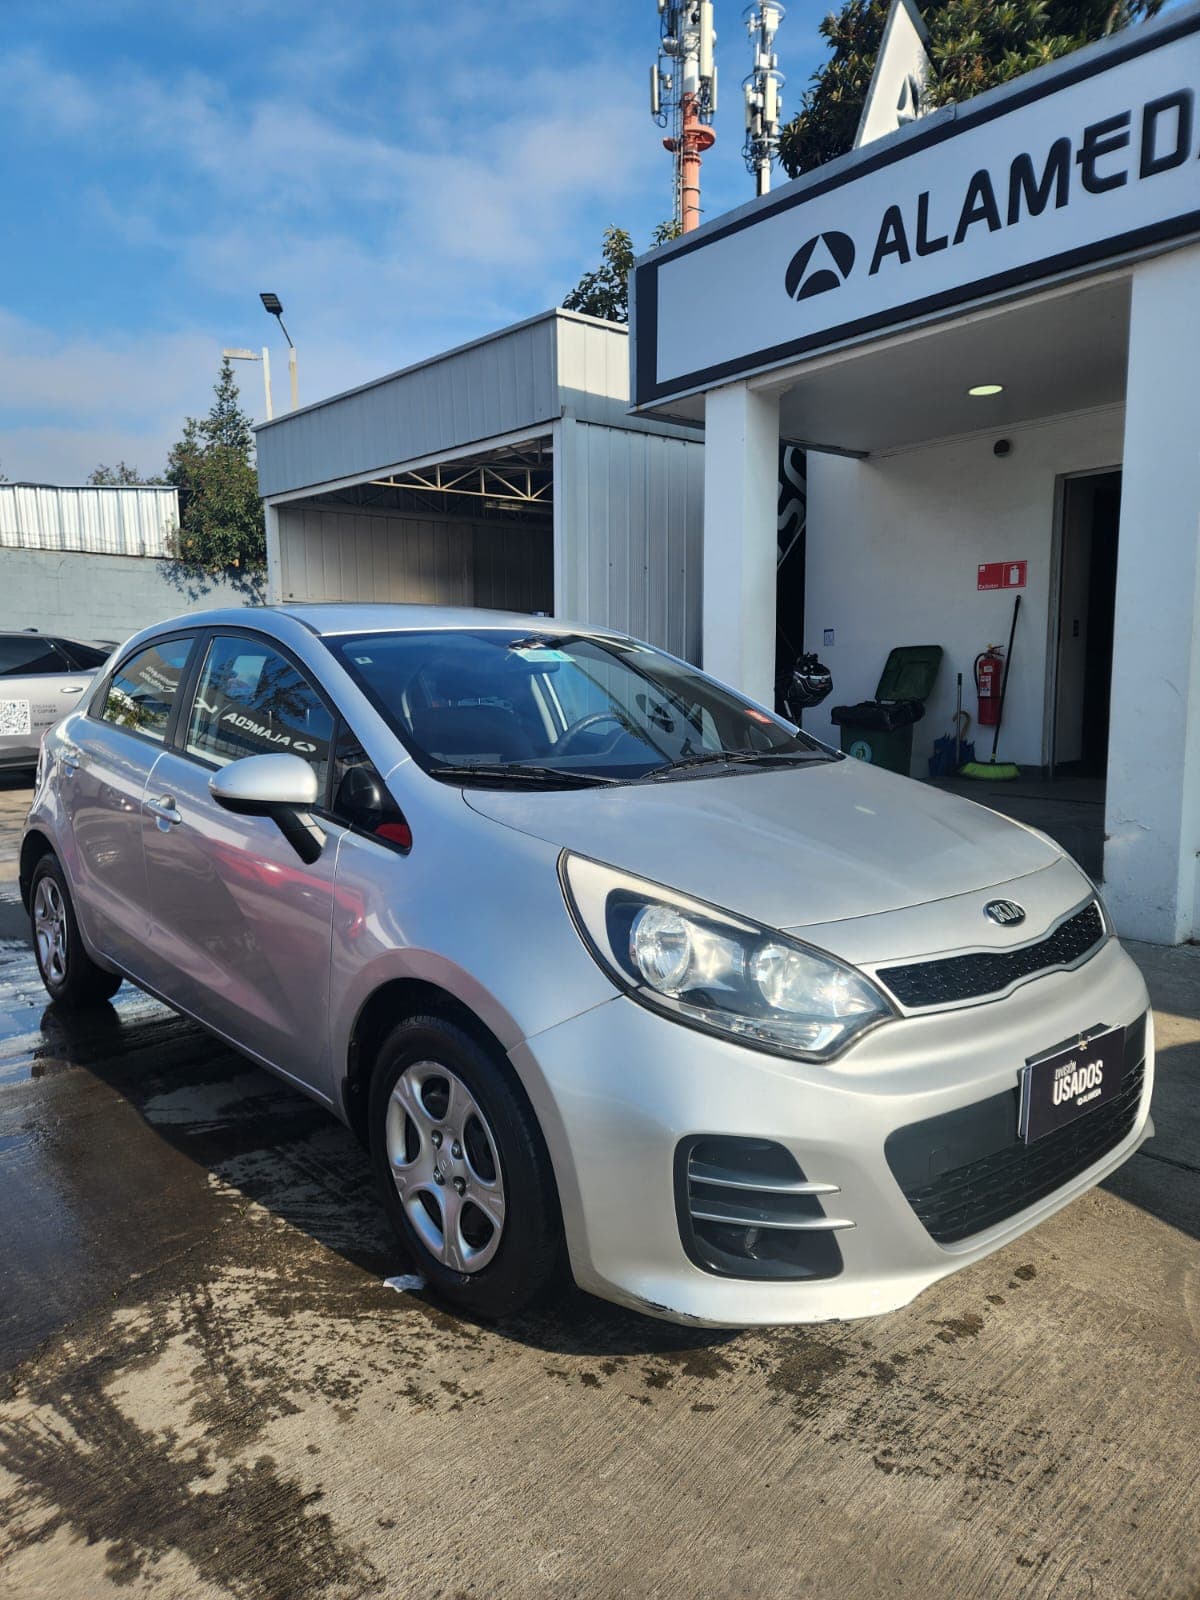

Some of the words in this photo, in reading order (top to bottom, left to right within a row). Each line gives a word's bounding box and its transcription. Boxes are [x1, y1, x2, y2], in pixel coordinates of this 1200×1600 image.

[868, 86, 1200, 276] ALAMED
[987, 901, 1025, 923] KIA
[1052, 1059, 1104, 1106] USADOS
